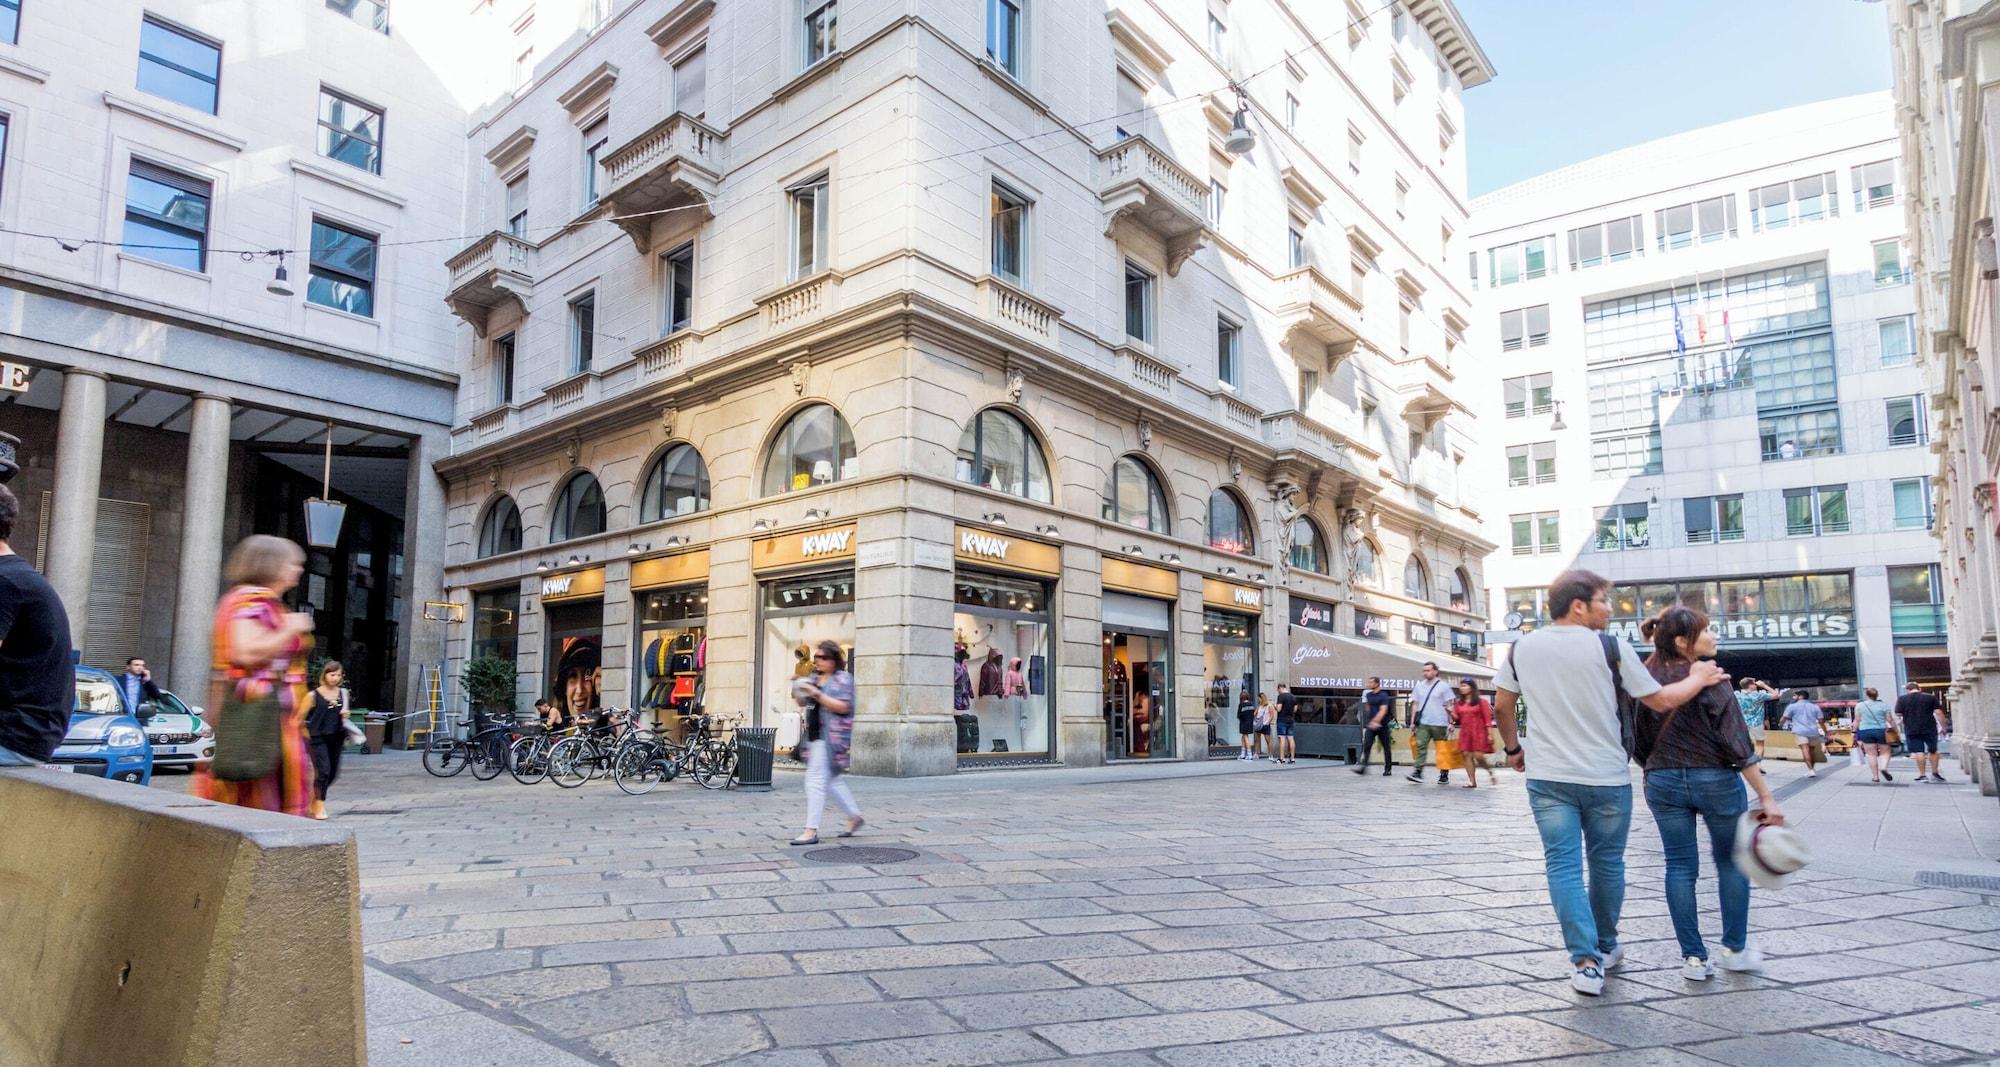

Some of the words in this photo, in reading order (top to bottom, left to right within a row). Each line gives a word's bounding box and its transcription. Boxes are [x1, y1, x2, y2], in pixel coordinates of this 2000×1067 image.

[1607, 614, 1850, 642] Monald's
[1300, 677, 1363, 687] RISTORANTE
[1377, 679, 1423, 689] IZZERI
